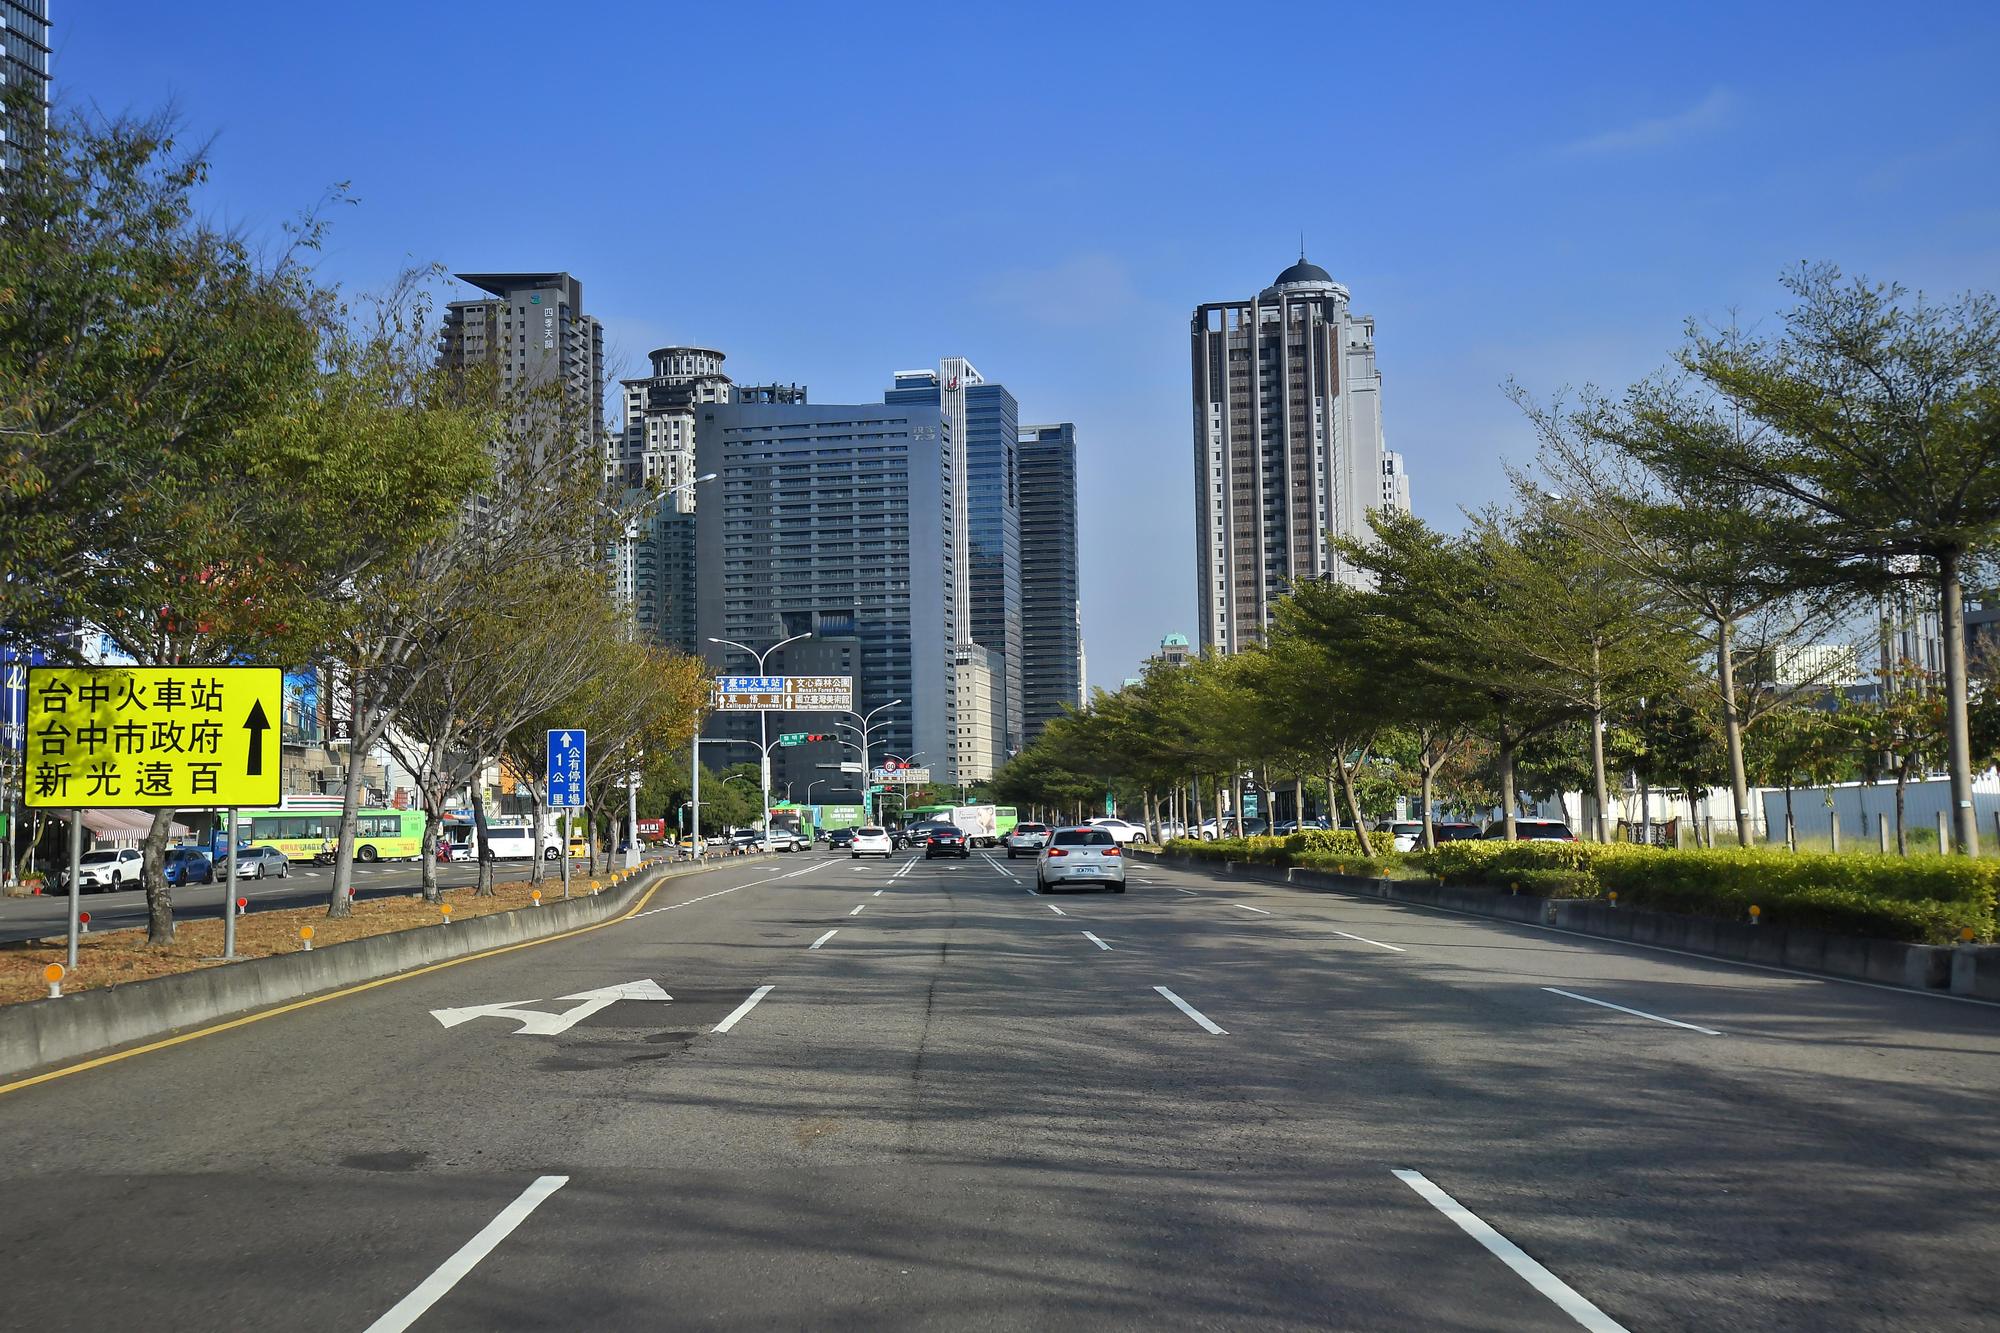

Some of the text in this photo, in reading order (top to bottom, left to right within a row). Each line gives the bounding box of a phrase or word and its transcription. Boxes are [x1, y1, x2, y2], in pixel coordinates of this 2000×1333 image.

[38, 677, 224, 713] 台中火車站
[728, 678, 780, 687] 臺中火車站
[728, 694, 780, 704] 草悟道
[796, 678, 850, 688] 文心森林公園
[36, 719, 223, 755] 台中市政府
[35, 761, 222, 798] 新光遠百
[552, 753, 564, 804] 1公里
[568, 747, 581, 804] 公有停車場
